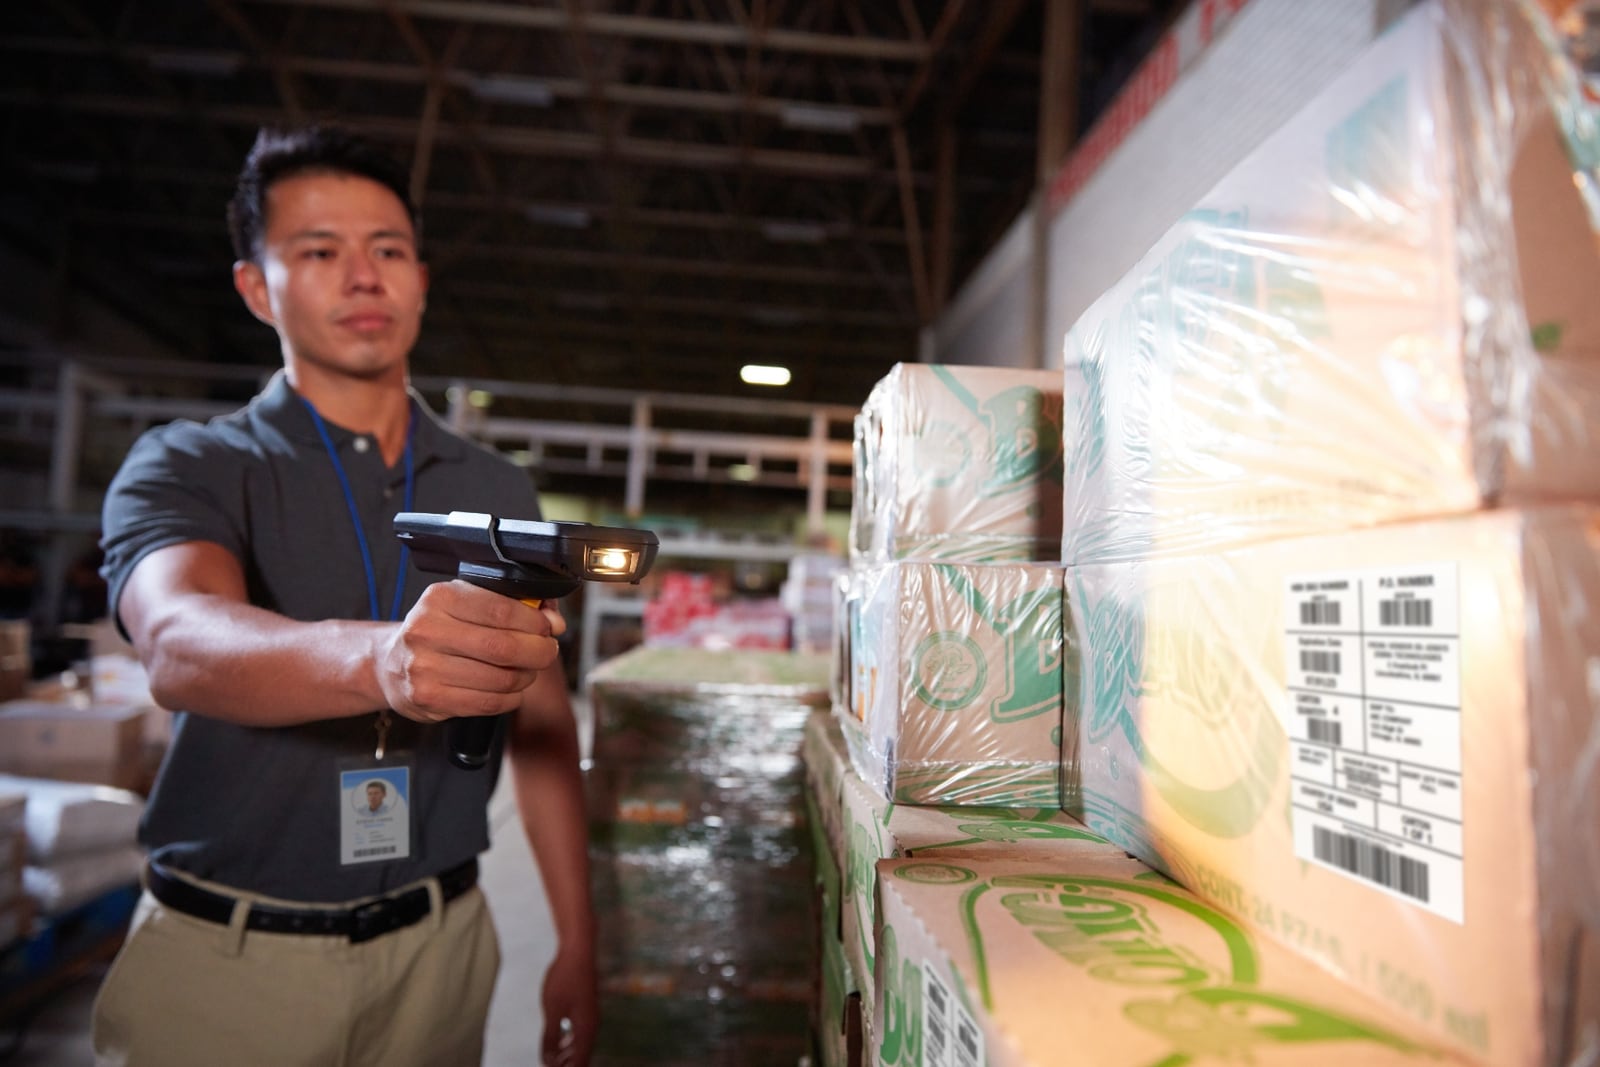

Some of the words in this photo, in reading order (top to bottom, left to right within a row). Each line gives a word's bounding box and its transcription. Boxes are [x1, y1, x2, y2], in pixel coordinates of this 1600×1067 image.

[1397, 574, 1434, 588] NUMBER
[1410, 827, 1423, 841] OF
[1197, 864, 1249, 915] CONT.
